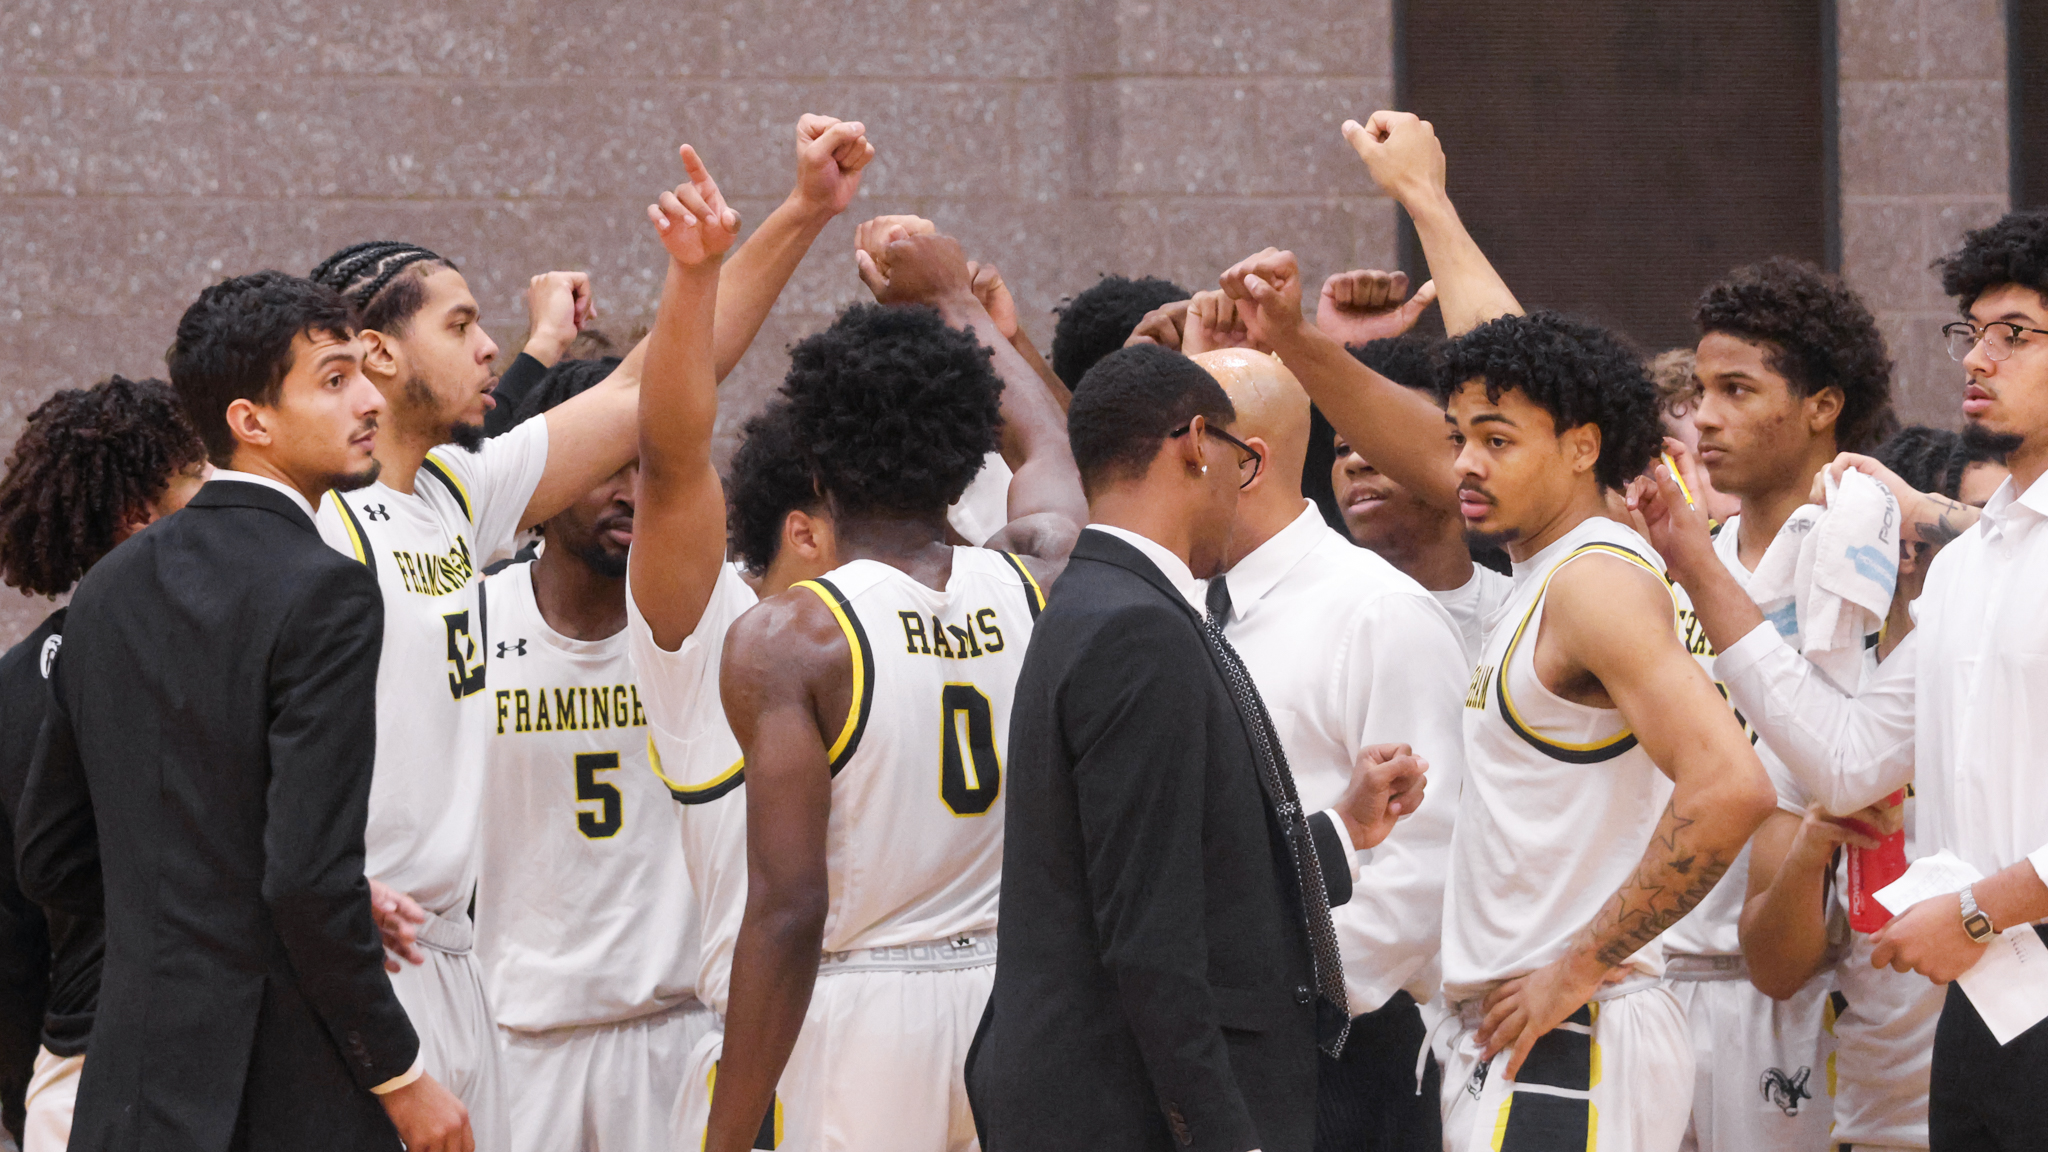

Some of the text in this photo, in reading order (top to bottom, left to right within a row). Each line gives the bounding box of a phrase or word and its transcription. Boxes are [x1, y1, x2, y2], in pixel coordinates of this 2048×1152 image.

[898, 607, 1005, 660] RAMS
[938, 681, 1002, 819] 0
[573, 751, 624, 841] 5
